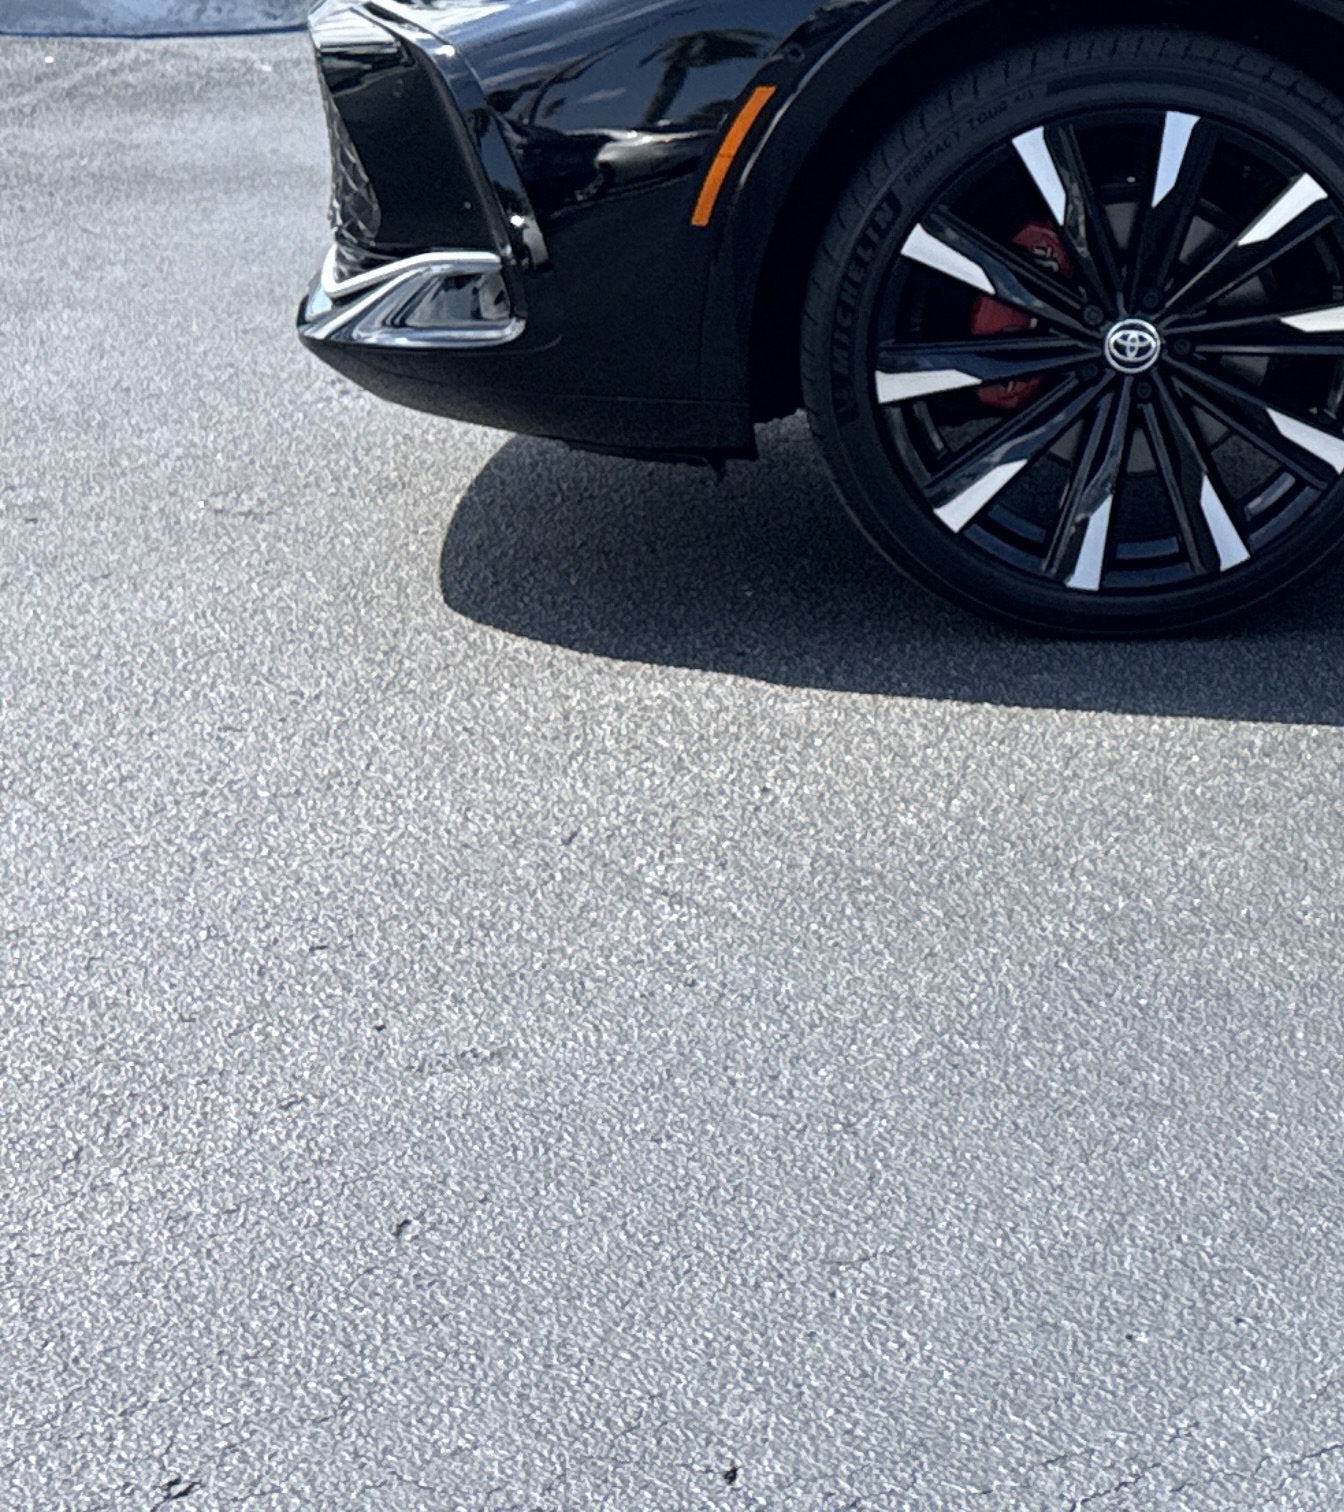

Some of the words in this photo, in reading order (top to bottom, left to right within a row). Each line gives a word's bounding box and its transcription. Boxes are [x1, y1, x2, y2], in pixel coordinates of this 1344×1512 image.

[904, 132, 960, 186] PRIMACY
[966, 100, 1008, 128] TOUR
[831, 198, 894, 375] MICHELIN
